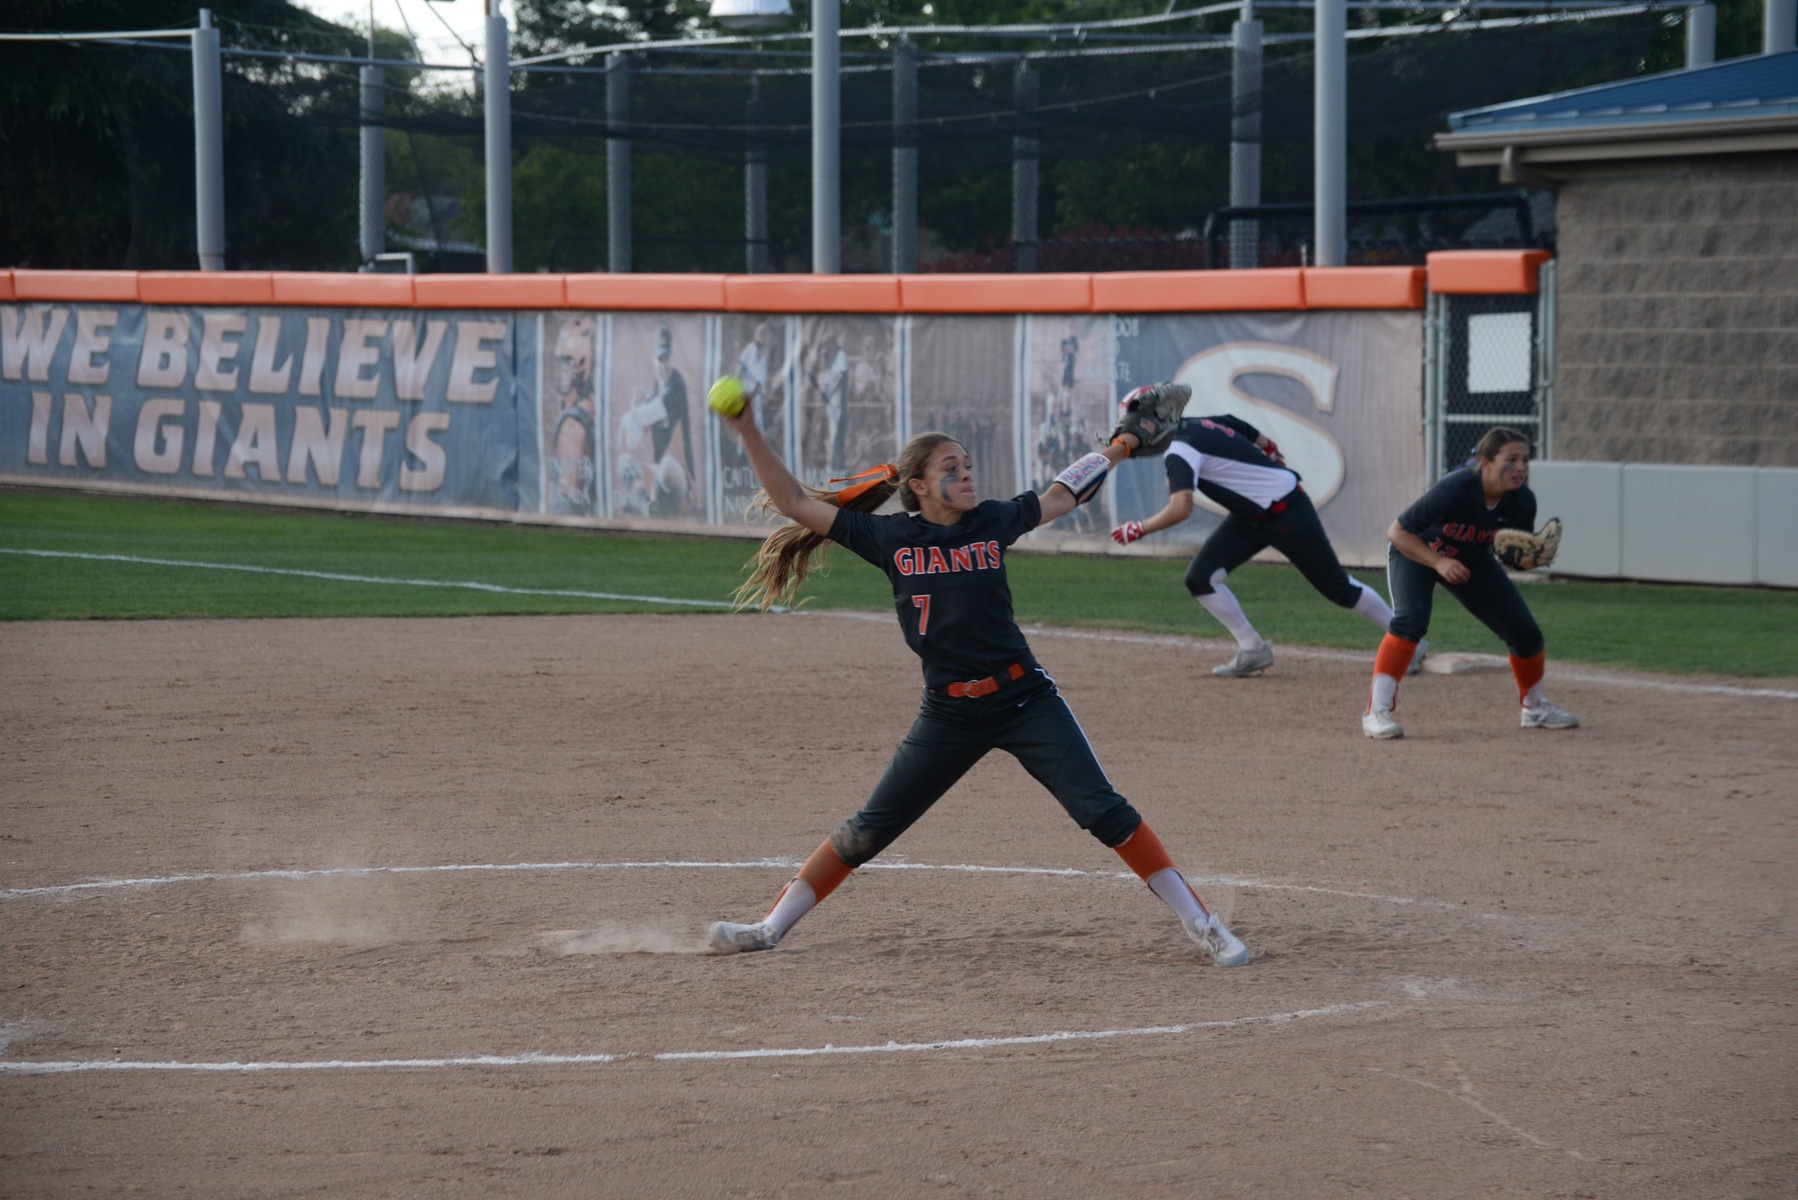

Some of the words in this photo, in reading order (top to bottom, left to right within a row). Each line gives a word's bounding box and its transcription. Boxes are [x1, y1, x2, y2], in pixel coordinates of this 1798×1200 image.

[1, 307, 118, 384] WE
[137, 311, 506, 403] BELIEVE
[28, 391, 112, 468] IN
[134, 397, 450, 490] GIANTS
[1173, 341, 1345, 518] S
[894, 540, 1001, 576] GIANTS
[911, 594, 931, 636] 7
